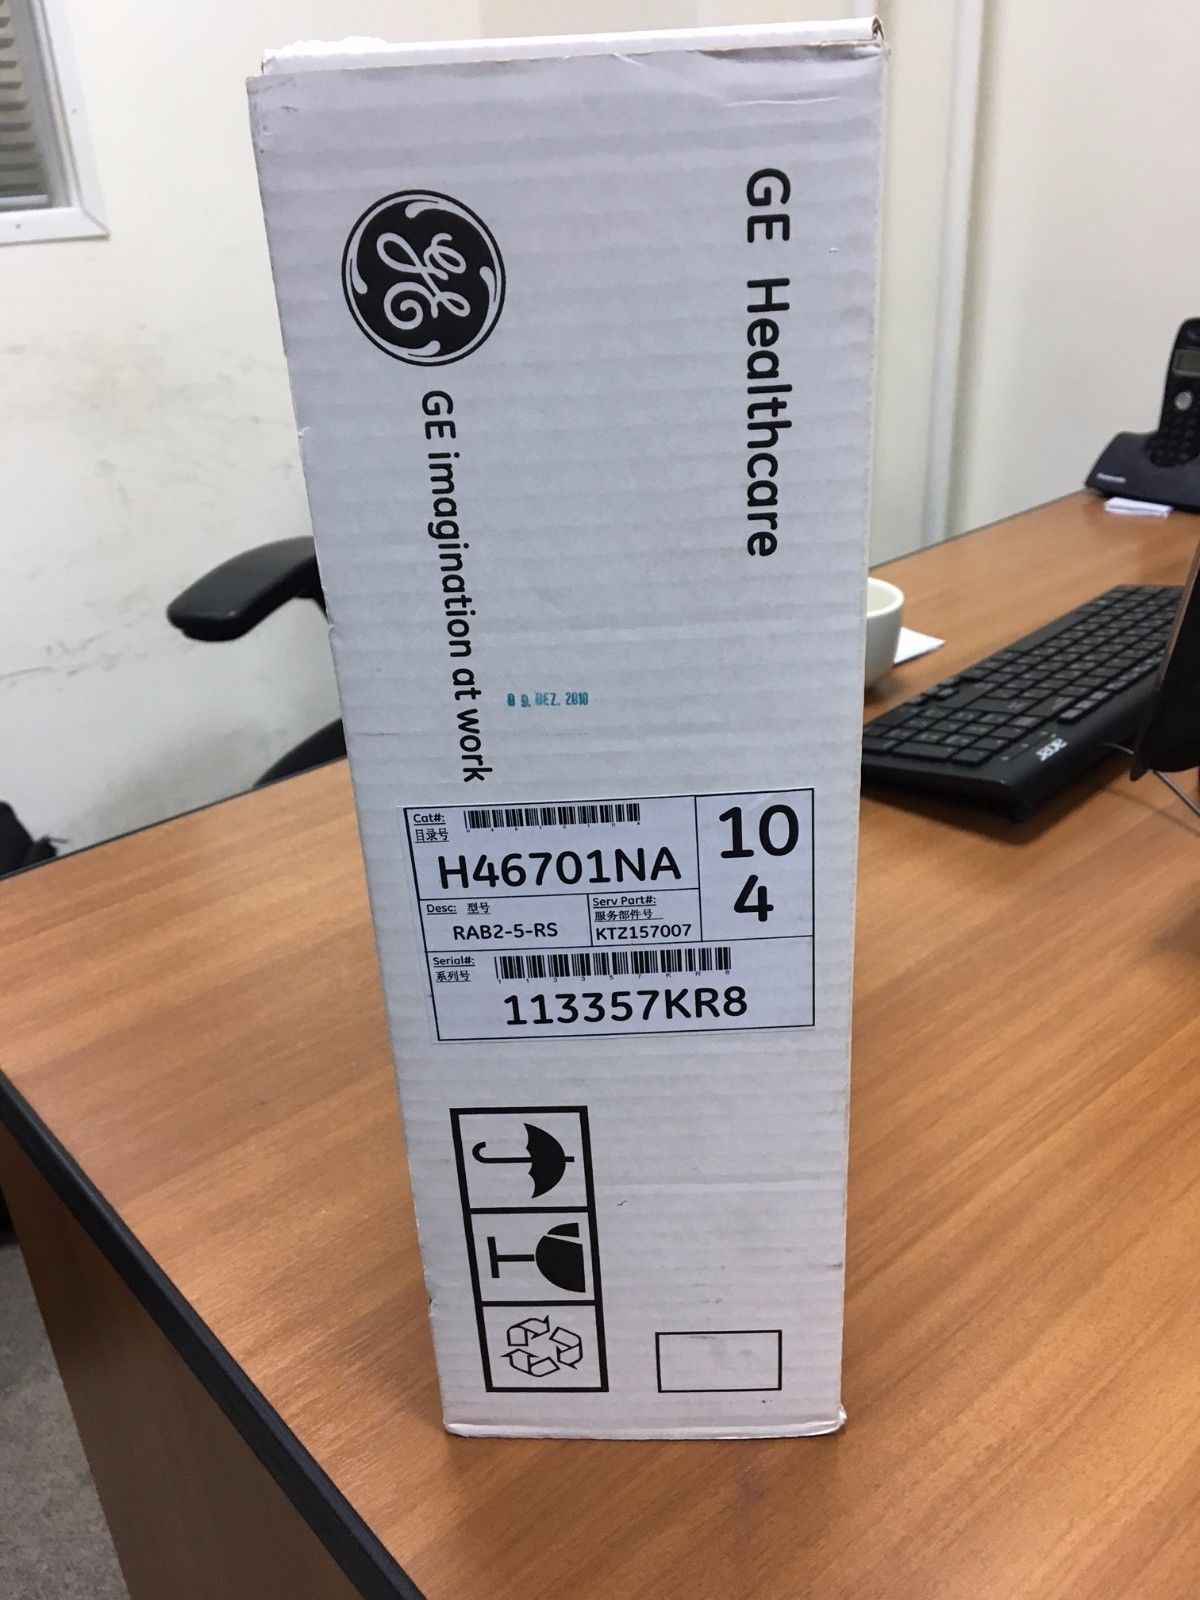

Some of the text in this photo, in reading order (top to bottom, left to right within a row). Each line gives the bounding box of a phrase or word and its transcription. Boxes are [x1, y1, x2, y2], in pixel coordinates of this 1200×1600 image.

[746, 168, 793, 557] GE Healthcare
[421, 390, 494, 783] GE imagination at work
[413, 813, 445, 824] Cat#:
[414, 827, 449, 842] 目录号
[718, 804, 800, 859] 10
[437, 846, 682, 890] H46701NA
[593, 895, 657, 907] Serv Part#:
[733, 874, 775, 922] 4
[426, 904, 457, 914] Desc:
[467, 902, 490, 914] 型号
[594, 908, 654, 922] 服务部件号
[452, 922, 559, 941] RAB2-5-RS
[595, 924, 692, 941] KTZ157007
[433, 956, 475, 966] Serial#:
[435, 970, 471, 982] 系列号
[503, 985, 748, 1026] 113357KR8
